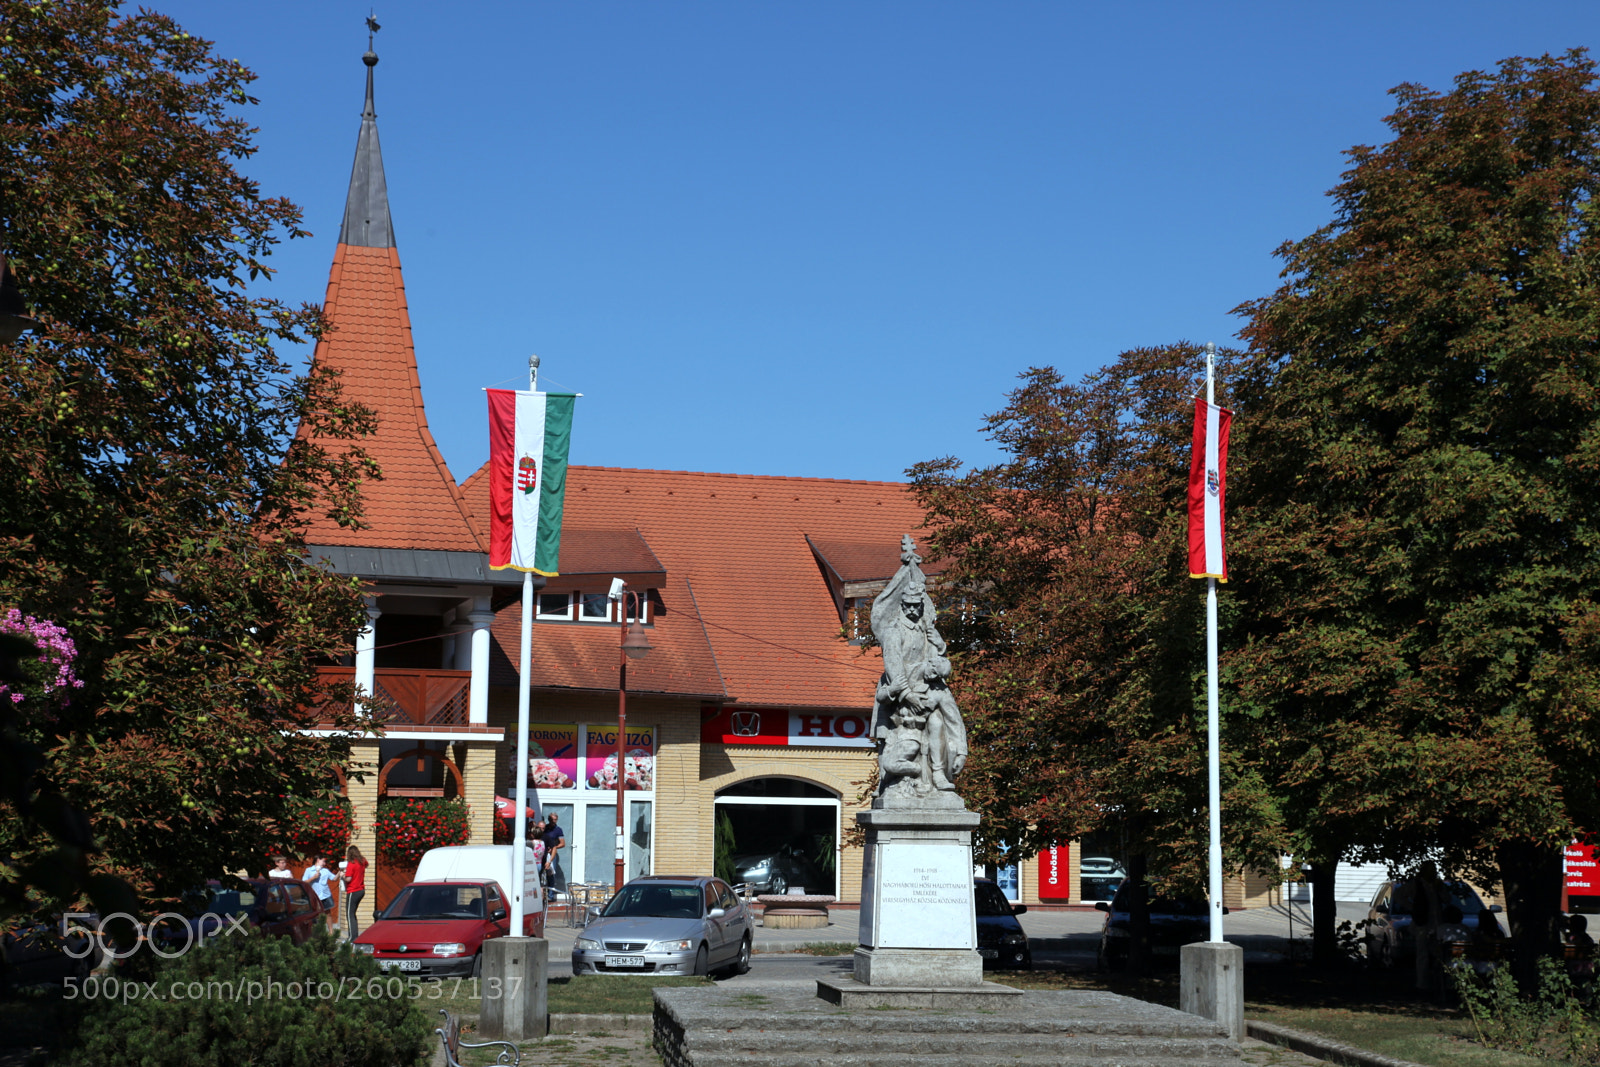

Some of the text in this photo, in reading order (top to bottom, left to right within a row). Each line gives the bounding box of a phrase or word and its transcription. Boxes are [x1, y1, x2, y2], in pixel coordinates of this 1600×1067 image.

[798, 715, 870, 738] HO
[528, 730, 652, 746] TORONY FAGIZÓ
[1049, 839, 1058, 884] Üdvözöl
[611, 957, 643, 965] HEM-577
